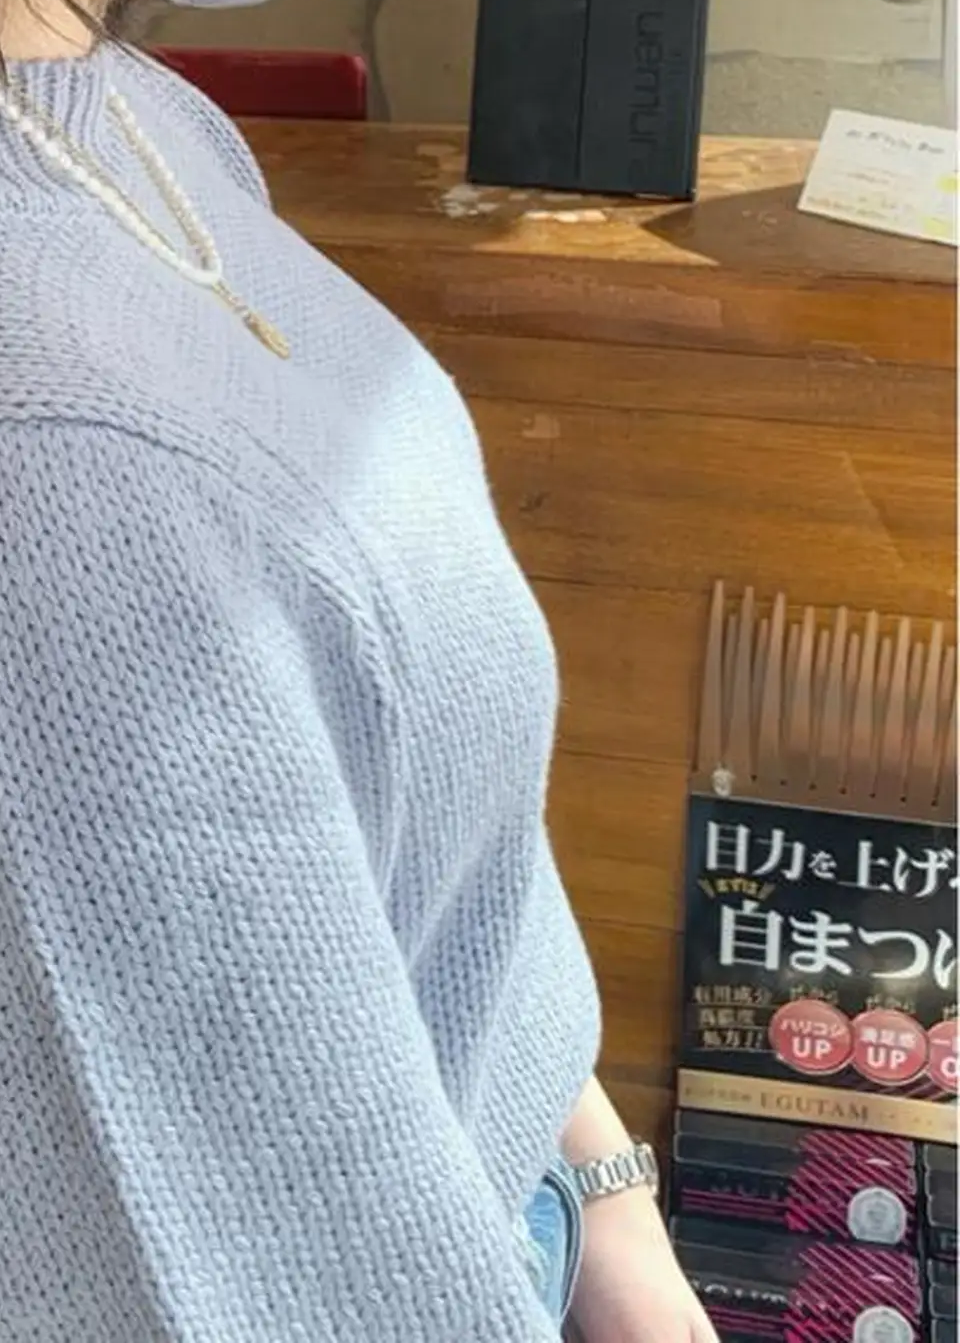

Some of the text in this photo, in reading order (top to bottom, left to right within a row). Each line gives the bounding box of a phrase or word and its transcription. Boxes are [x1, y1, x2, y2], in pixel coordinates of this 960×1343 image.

[705, 820, 958, 898] 目力を上げ
[792, 1036, 832, 1060] UP
[867, 1046, 908, 1070] UP
